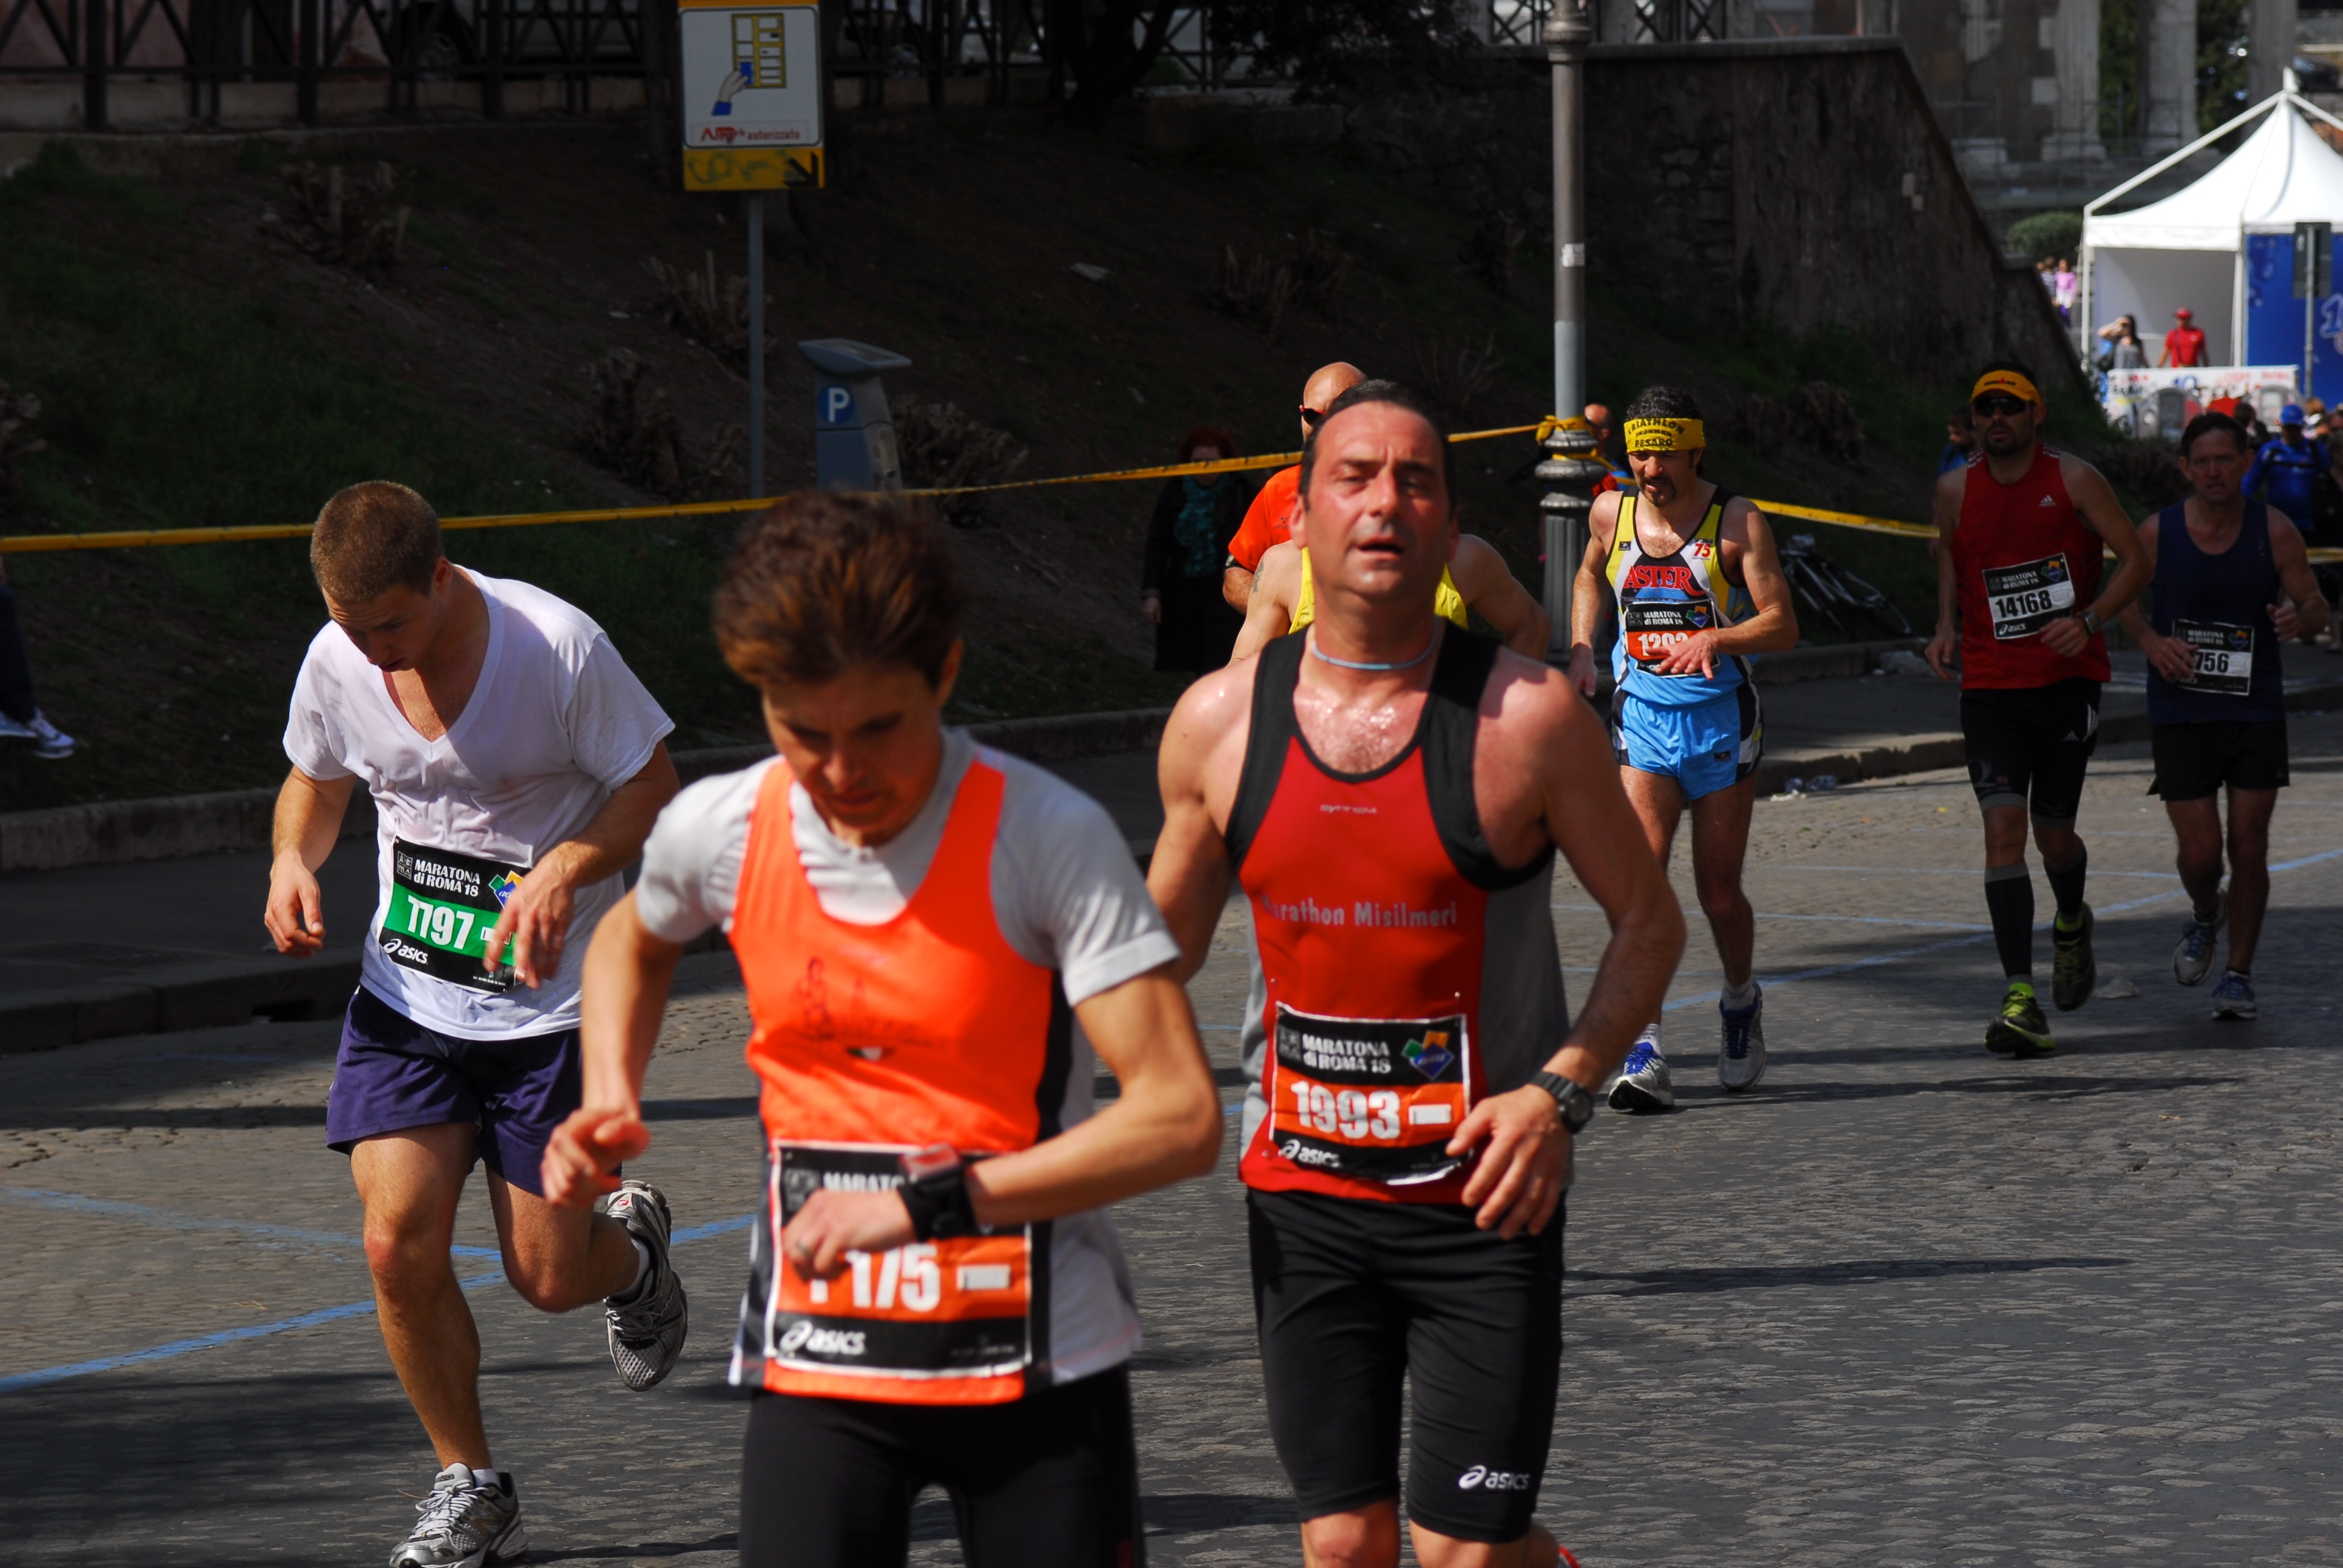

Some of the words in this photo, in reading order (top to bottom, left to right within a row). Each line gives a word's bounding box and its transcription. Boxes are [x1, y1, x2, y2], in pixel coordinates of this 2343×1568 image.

[828, 387, 850, 422] P
[1635, 438, 1673, 448] PESARO
[1694, 543, 1711, 558] 75
[1623, 564, 1706, 597] ASTER
[1995, 589, 2053, 618] 14168
[2008, 623, 2026, 633] asics
[415, 858, 480, 885] MARATONA
[413, 871, 425, 885] di
[426, 874, 462, 893] ROMA
[464, 884, 479, 897] 18
[397, 944, 428, 965] asics
[1302, 1033, 1391, 1057] MARATONA
[1318, 1053, 1367, 1072] ROMA
[1290, 1080, 1401, 1140] 1993
[1298, 1147, 1340, 1168] asics
[822, 1171, 917, 1191] MARATO
[806, 1329, 865, 1356] asics
[1484, 1471, 1530, 1490] asics
